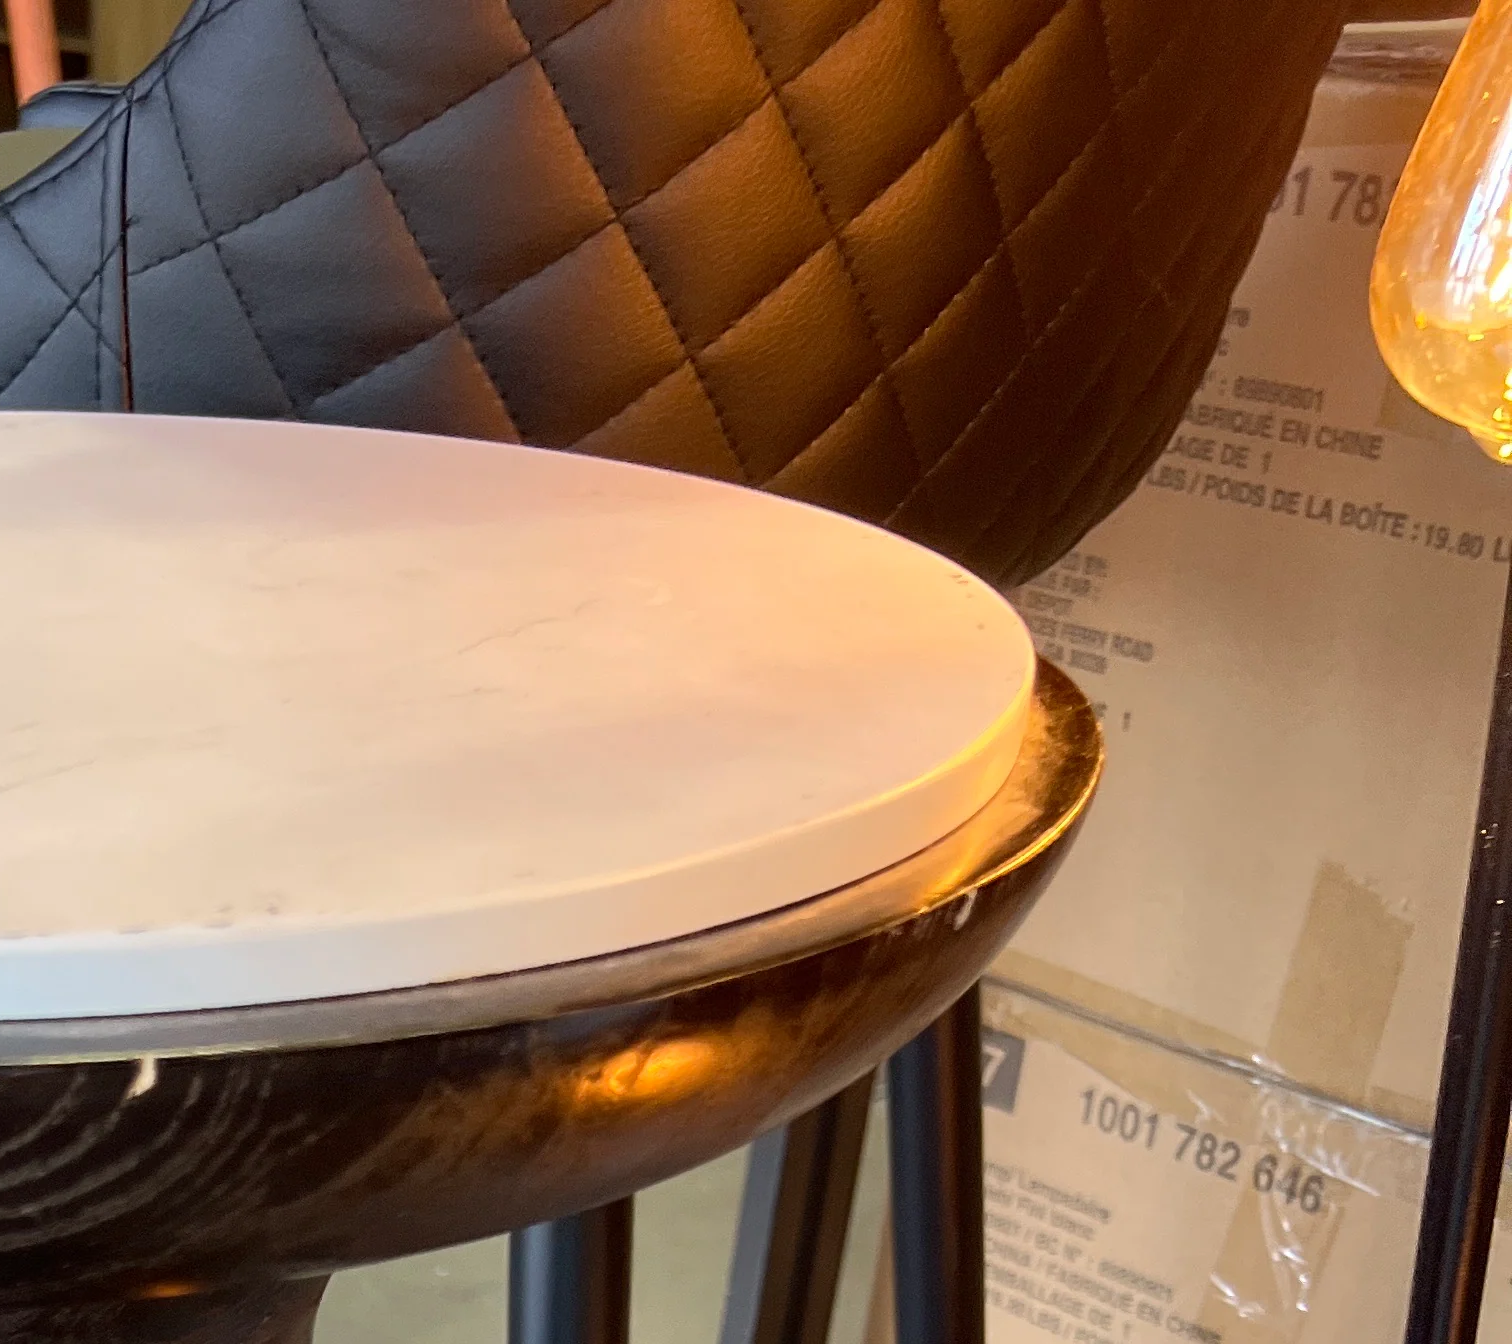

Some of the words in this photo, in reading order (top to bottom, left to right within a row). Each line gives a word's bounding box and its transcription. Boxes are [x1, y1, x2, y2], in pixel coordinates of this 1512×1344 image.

[1327, 169, 1400, 227] 78
[1220, 443, 1249, 470] DE
[1279, 418, 1311, 448] EN
[1314, 425, 1383, 461] CHINE
[1201, 474, 1266, 508] POIDS
[1270, 488, 1302, 516] DE
[1305, 494, 1333, 525] LA
[1492, 535, 1512, 563] L
[1080, 1087, 1160, 1151] 1001
[1174, 1123, 1241, 1182] 782
[1252, 1152, 1325, 1214] 646
